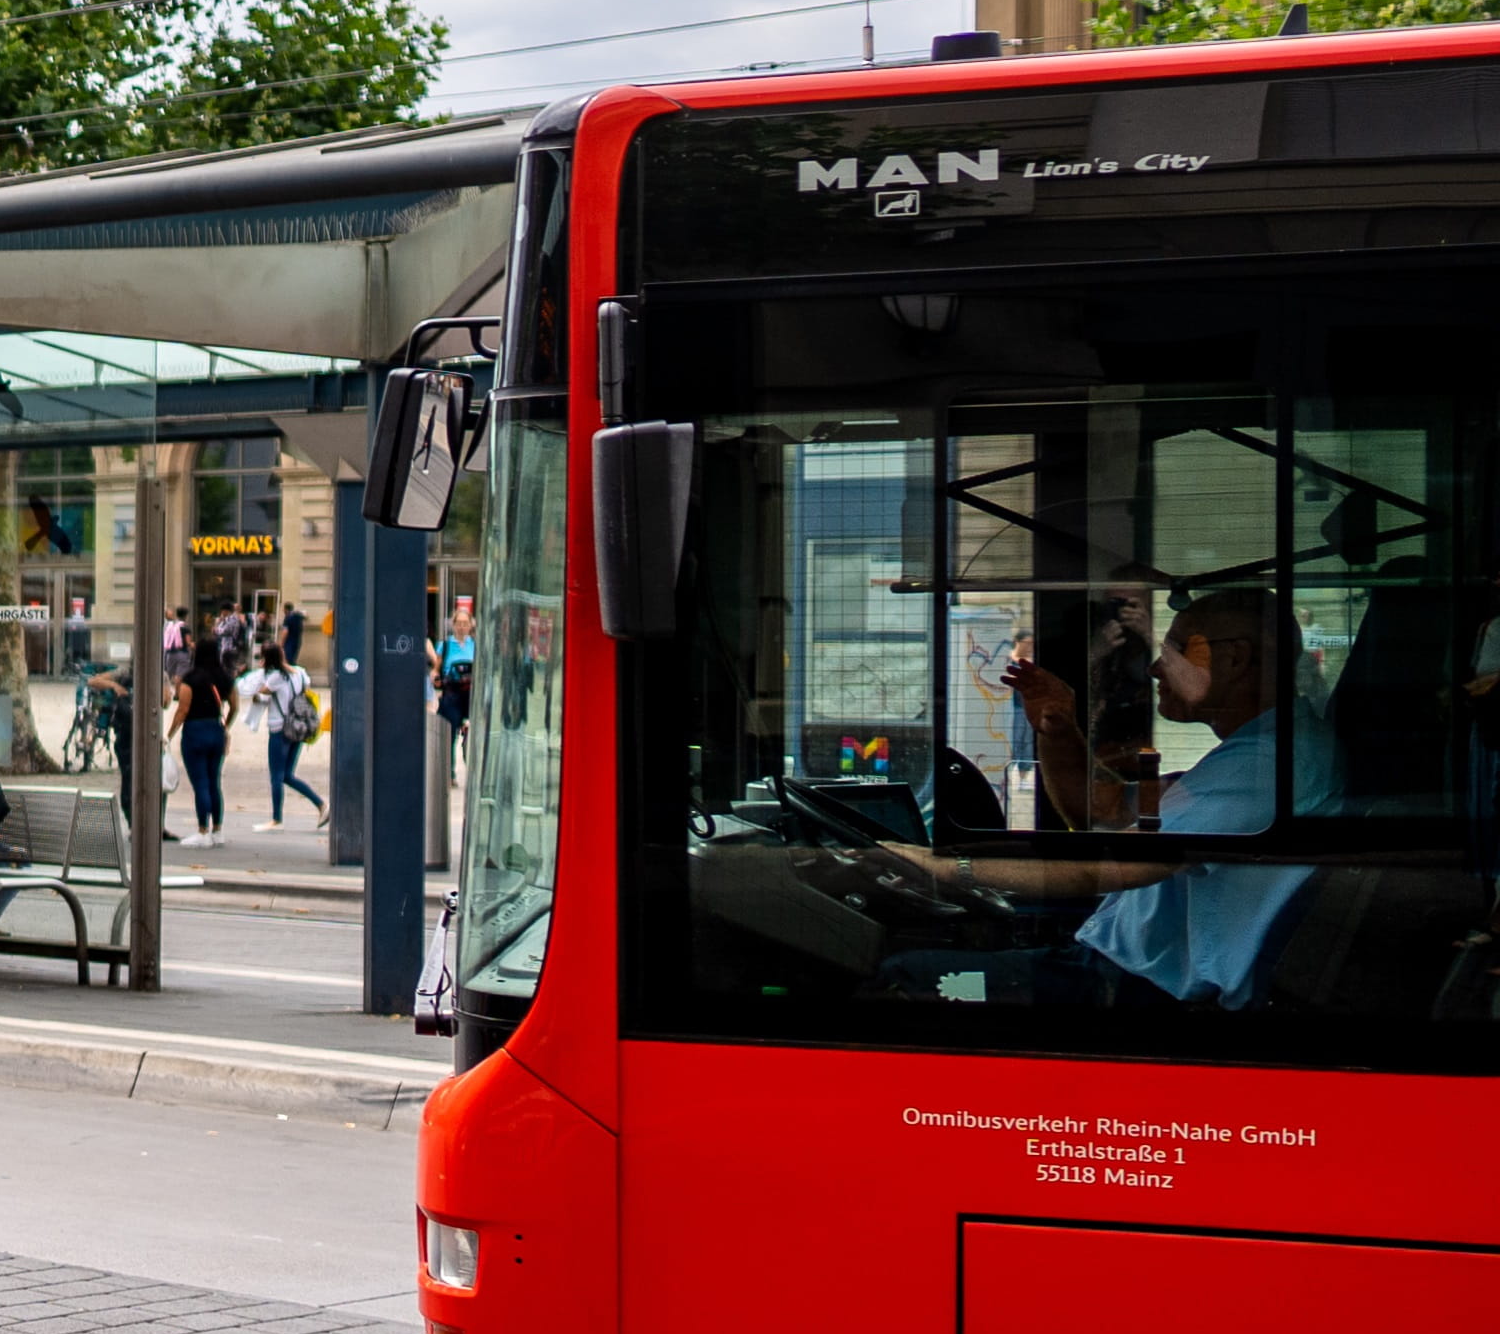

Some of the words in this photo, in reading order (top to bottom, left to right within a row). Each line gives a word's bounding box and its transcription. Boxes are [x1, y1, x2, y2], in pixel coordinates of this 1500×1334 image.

[797, 148, 999, 192] MAN
[1022, 156, 1119, 179] Lion's
[1132, 153, 1211, 172] City
[190, 535, 274, 555] YORMA'S
[902, 1107, 1088, 1135] Omnibusverkehr
[1096, 1117, 1232, 1142] Rhein-Nahe
[1240, 1125, 1317, 1147] GmbH
[1025, 1138, 1167, 1164] Erthalstraße
[1174, 1147, 1186, 1165] 1
[1035, 1164, 1096, 1184] 55118
[1103, 1167, 1174, 1189] Mainz
